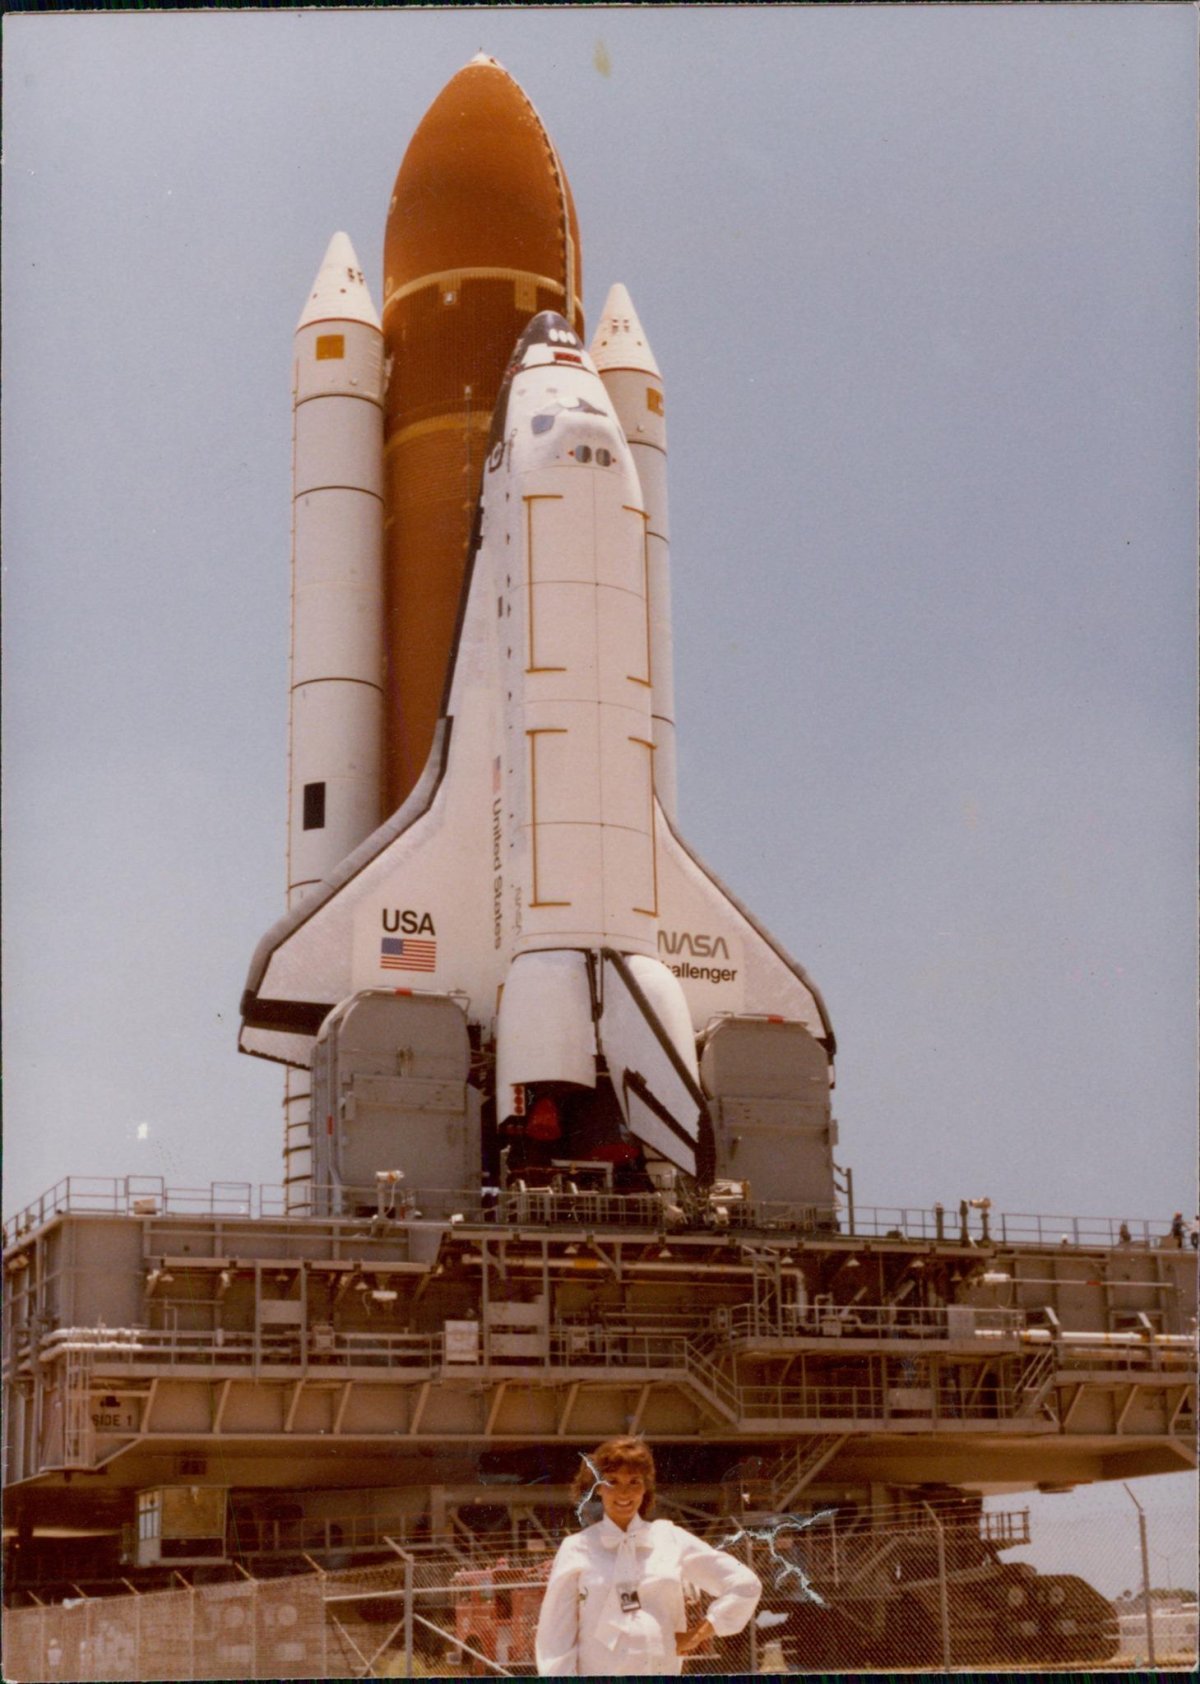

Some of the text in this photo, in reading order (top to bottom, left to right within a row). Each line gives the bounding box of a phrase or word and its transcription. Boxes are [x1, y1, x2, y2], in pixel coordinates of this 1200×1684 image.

[382, 908, 436, 936] USA
[657, 929, 730, 960] NASA
[661, 960, 738, 984] allenger
[92, 1414, 132, 1427] SIDE 1
